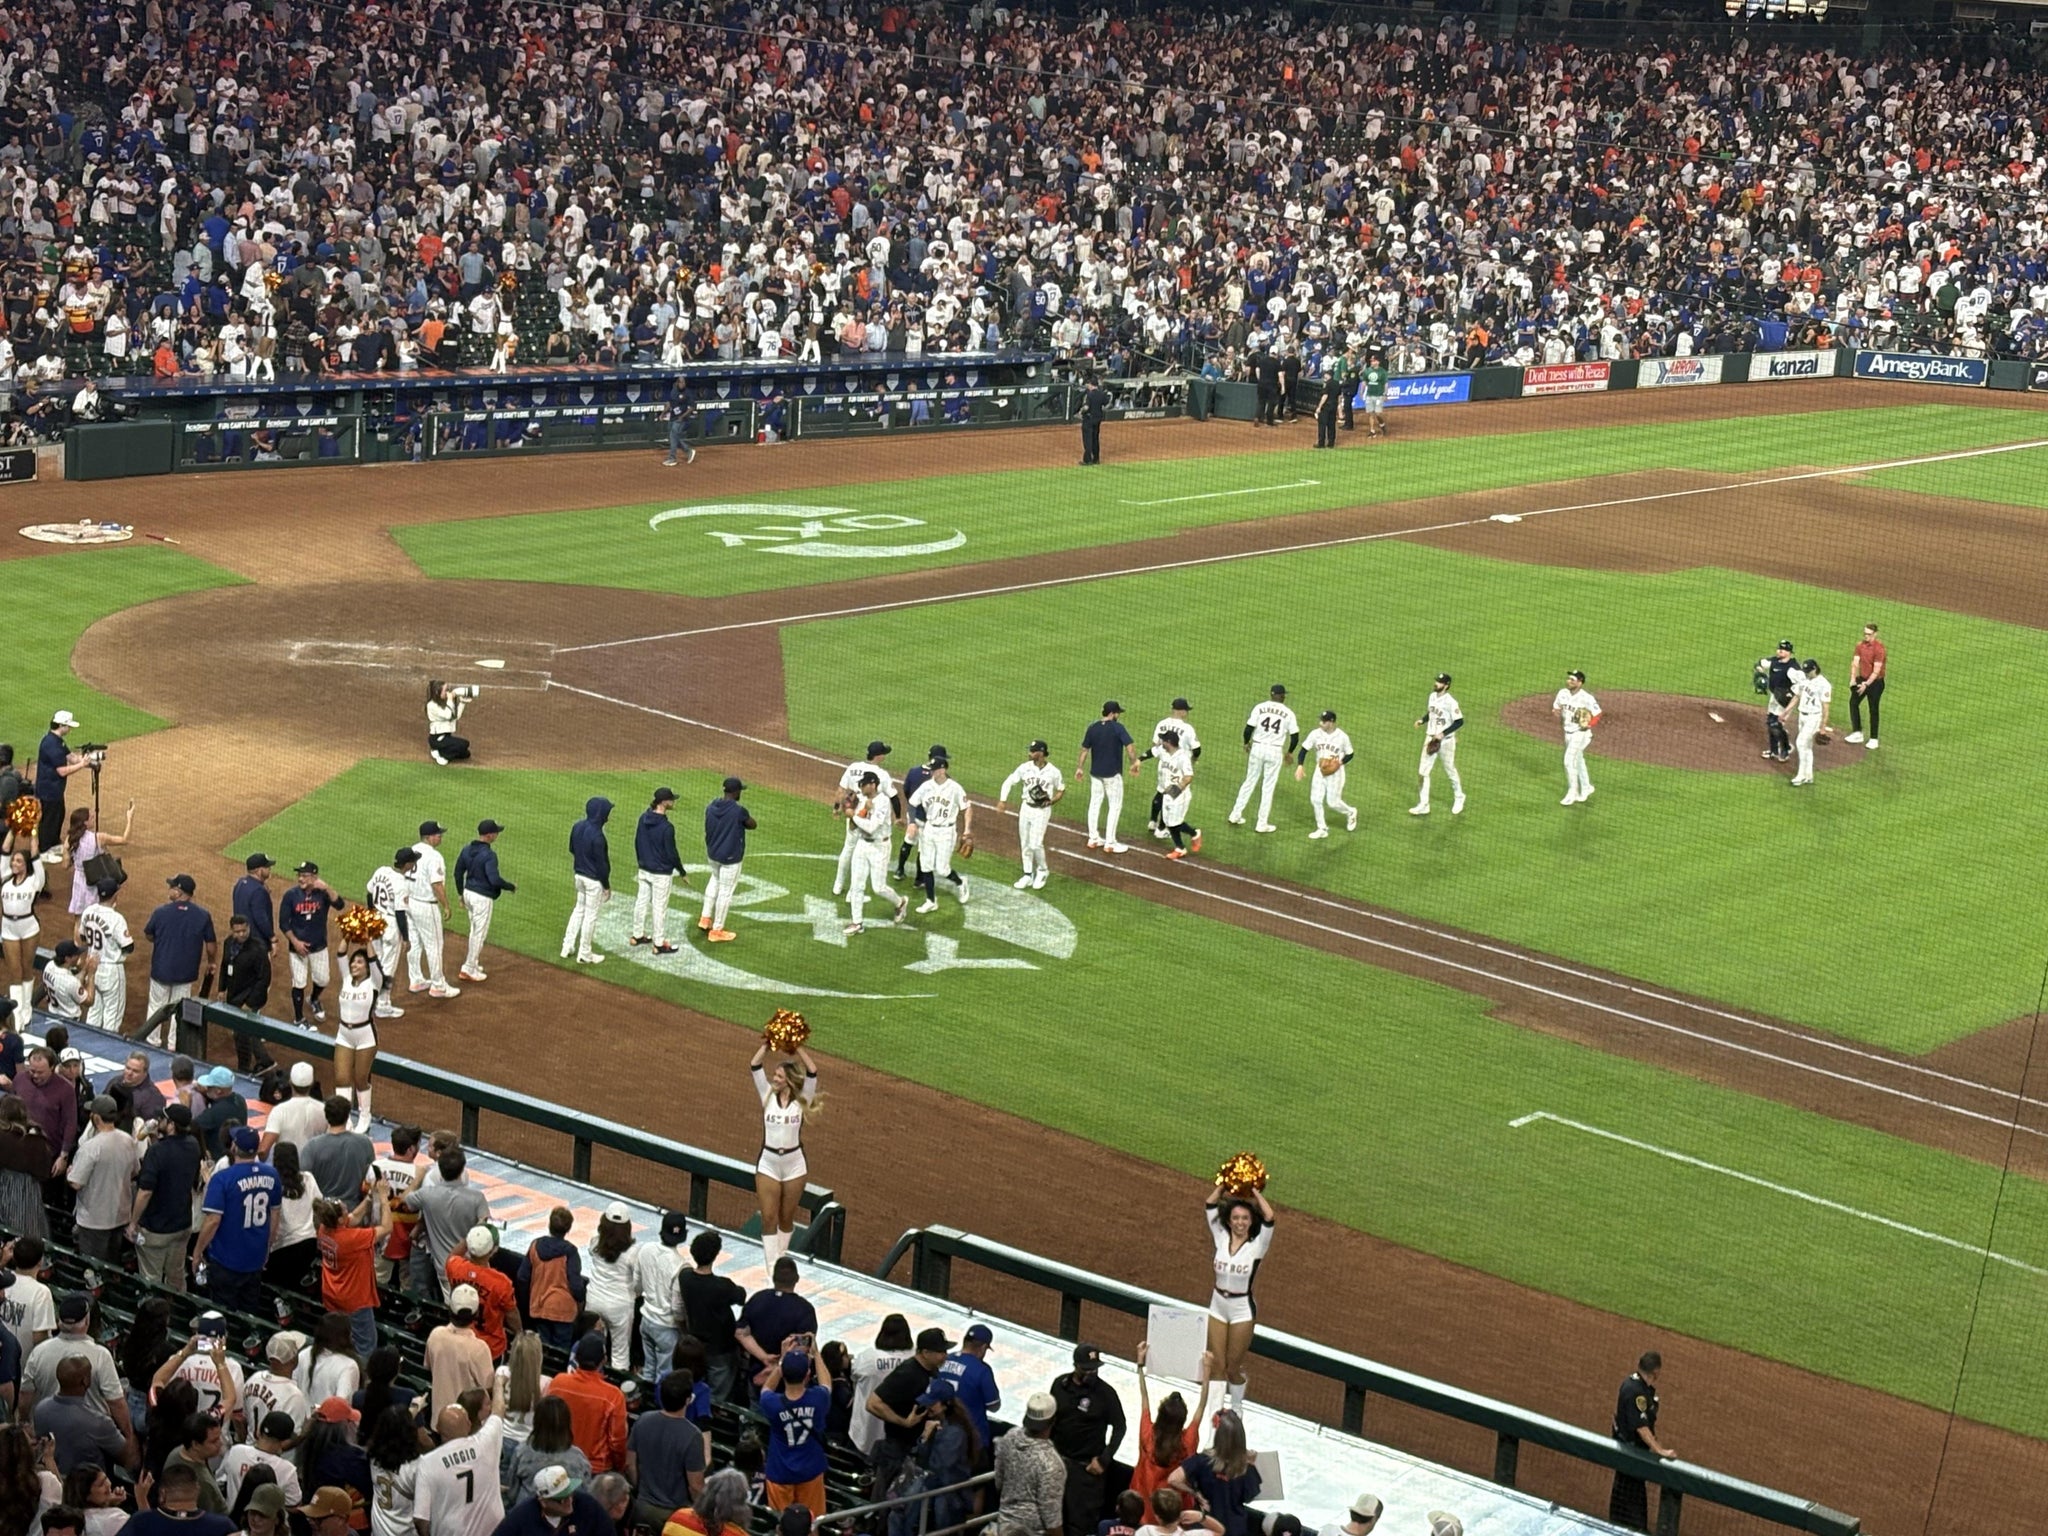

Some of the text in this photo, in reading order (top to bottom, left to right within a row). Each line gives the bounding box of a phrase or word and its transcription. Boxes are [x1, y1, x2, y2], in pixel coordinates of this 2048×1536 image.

[1528, 365, 1606, 383] Don't mess with Texas
[1669, 360, 1699, 375] ARROW
[1261, 717, 1282, 734] 44
[937, 807, 949, 819] 16
[373, 884, 388, 909] 12
[86, 926, 103, 950] 99
[237, 1175, 275, 1192] YAMAMOTO
[243, 1191, 269, 1229] 18
[784, 1418, 813, 1446] 17
[441, 1447, 477, 1469] BIGGIO
[456, 1469, 474, 1504] 7
